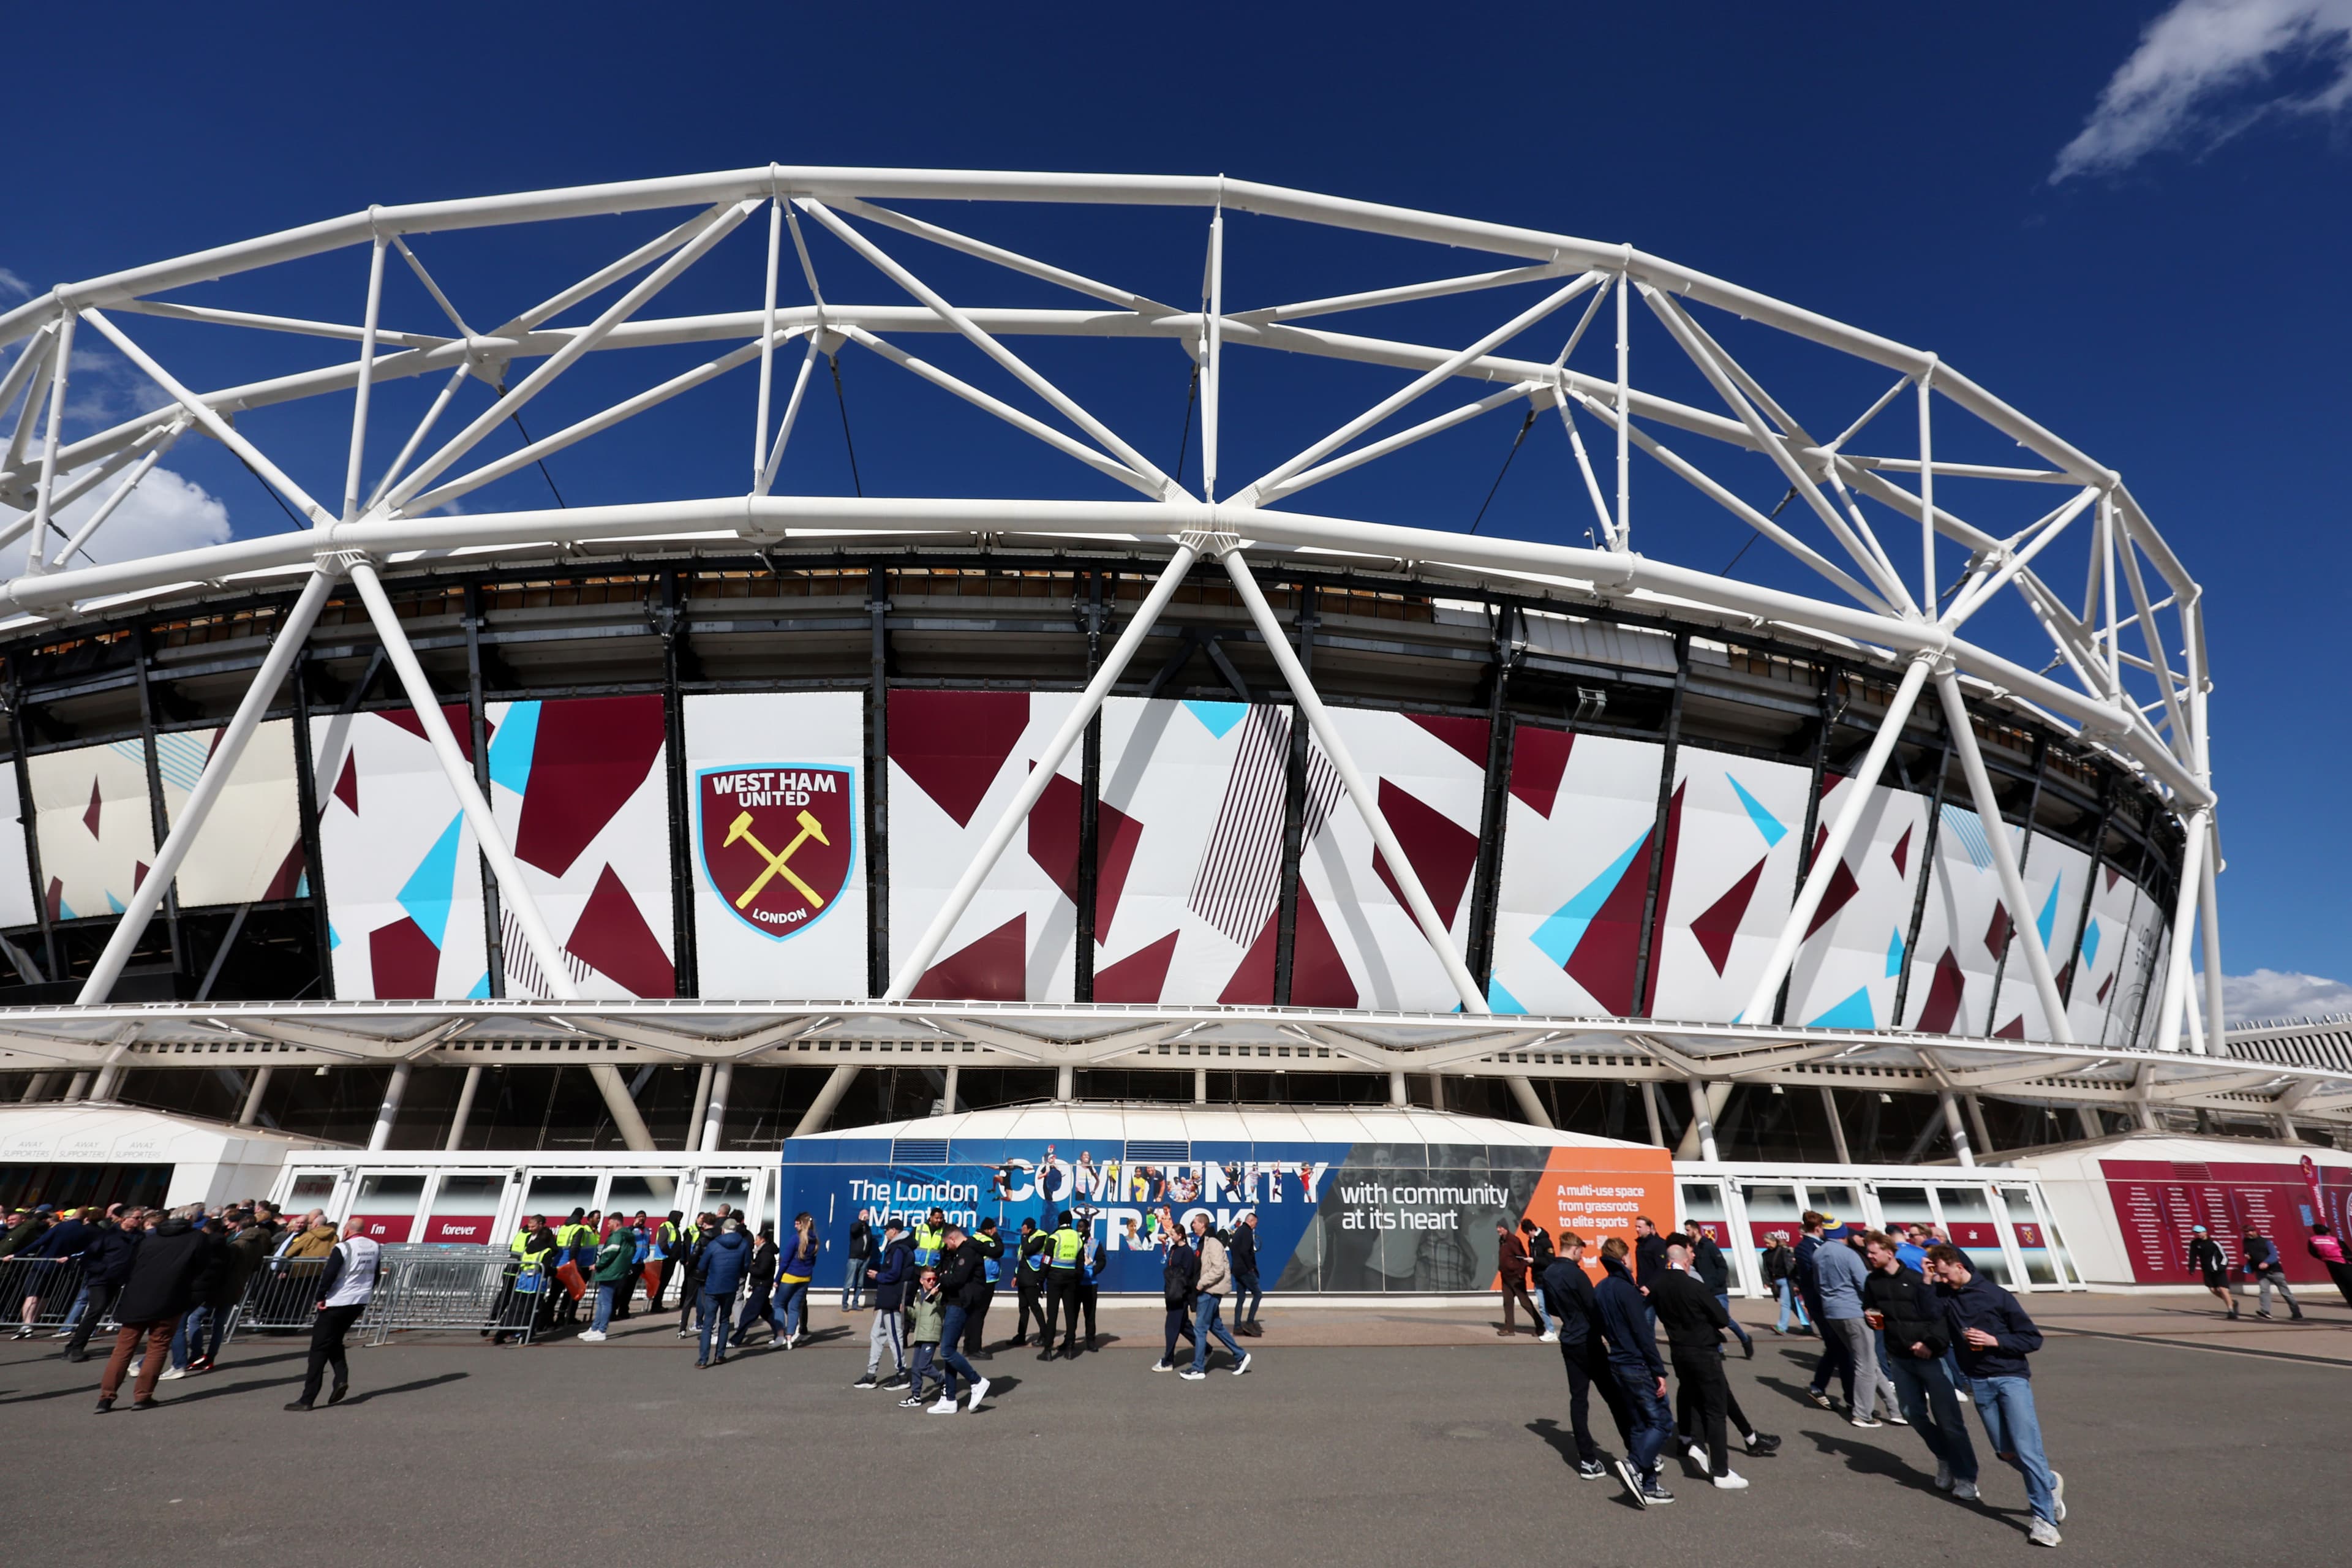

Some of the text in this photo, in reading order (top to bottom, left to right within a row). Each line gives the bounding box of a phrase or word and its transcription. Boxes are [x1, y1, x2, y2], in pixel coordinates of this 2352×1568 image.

[712, 772, 837, 795] WEST HAM
[738, 791, 810, 807] UNITED
[752, 907, 808, 924] LONDON
[999, 1158, 1329, 1203] COMMUNITY
[849, 1179, 978, 1202] The London
[1341, 1182, 1509, 1208] with community
[1557, 1184, 1645, 1199] A multi-use space
[1558, 1200, 1640, 1214] from grassroots
[869, 1206, 977, 1228] Maraon
[1342, 1207, 1459, 1230] at its heart
[1559, 1215, 1629, 1229] to elite sports
[370, 1223, 386, 1235] I'm
[442, 1223, 477, 1235] forever
[1967, 1229, 1978, 1239] air
